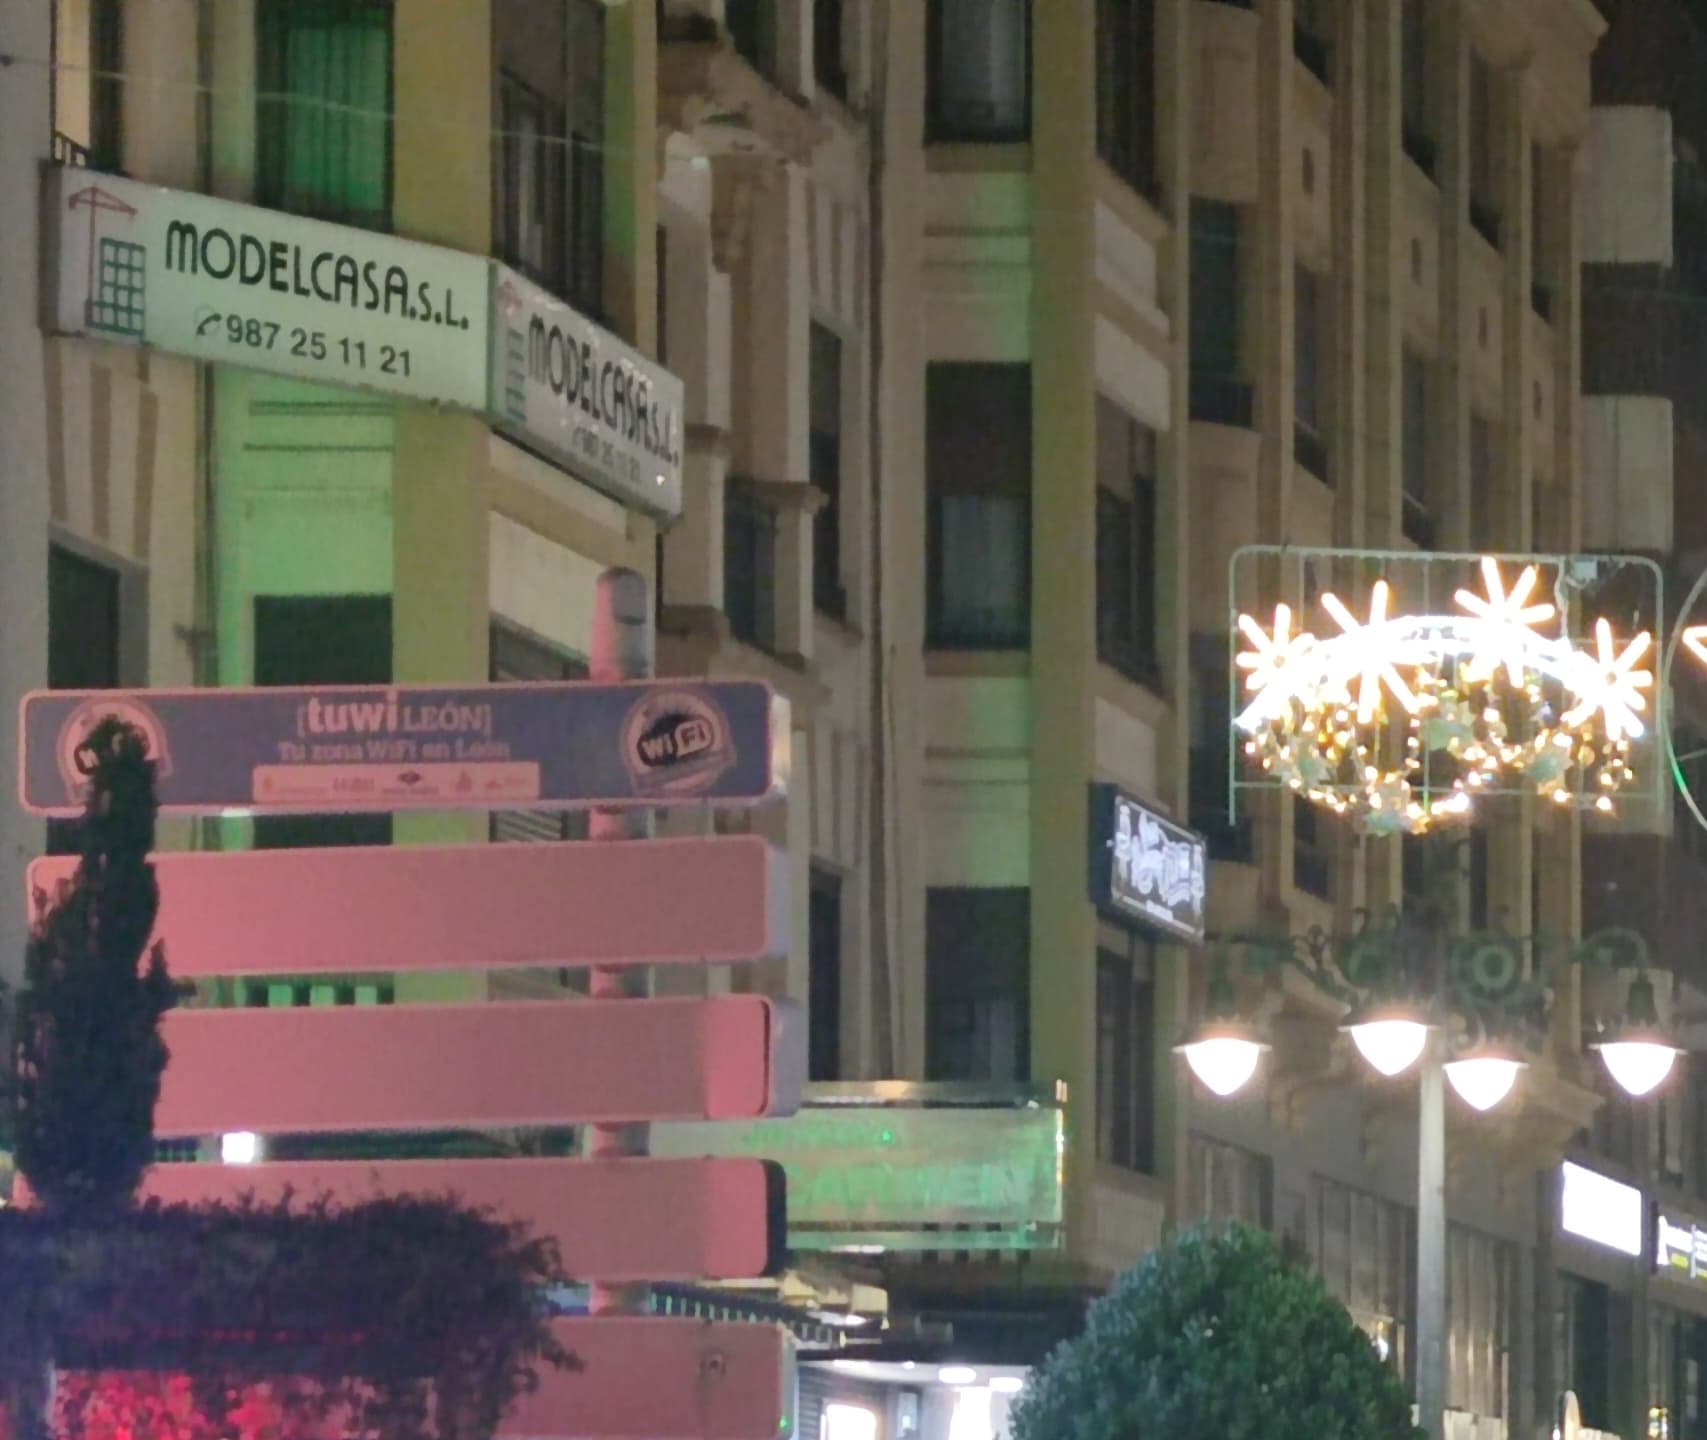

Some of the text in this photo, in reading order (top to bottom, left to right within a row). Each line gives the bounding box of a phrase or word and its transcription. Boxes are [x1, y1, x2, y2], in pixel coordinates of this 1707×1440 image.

[226, 314, 410, 377] 987 25 11 21
